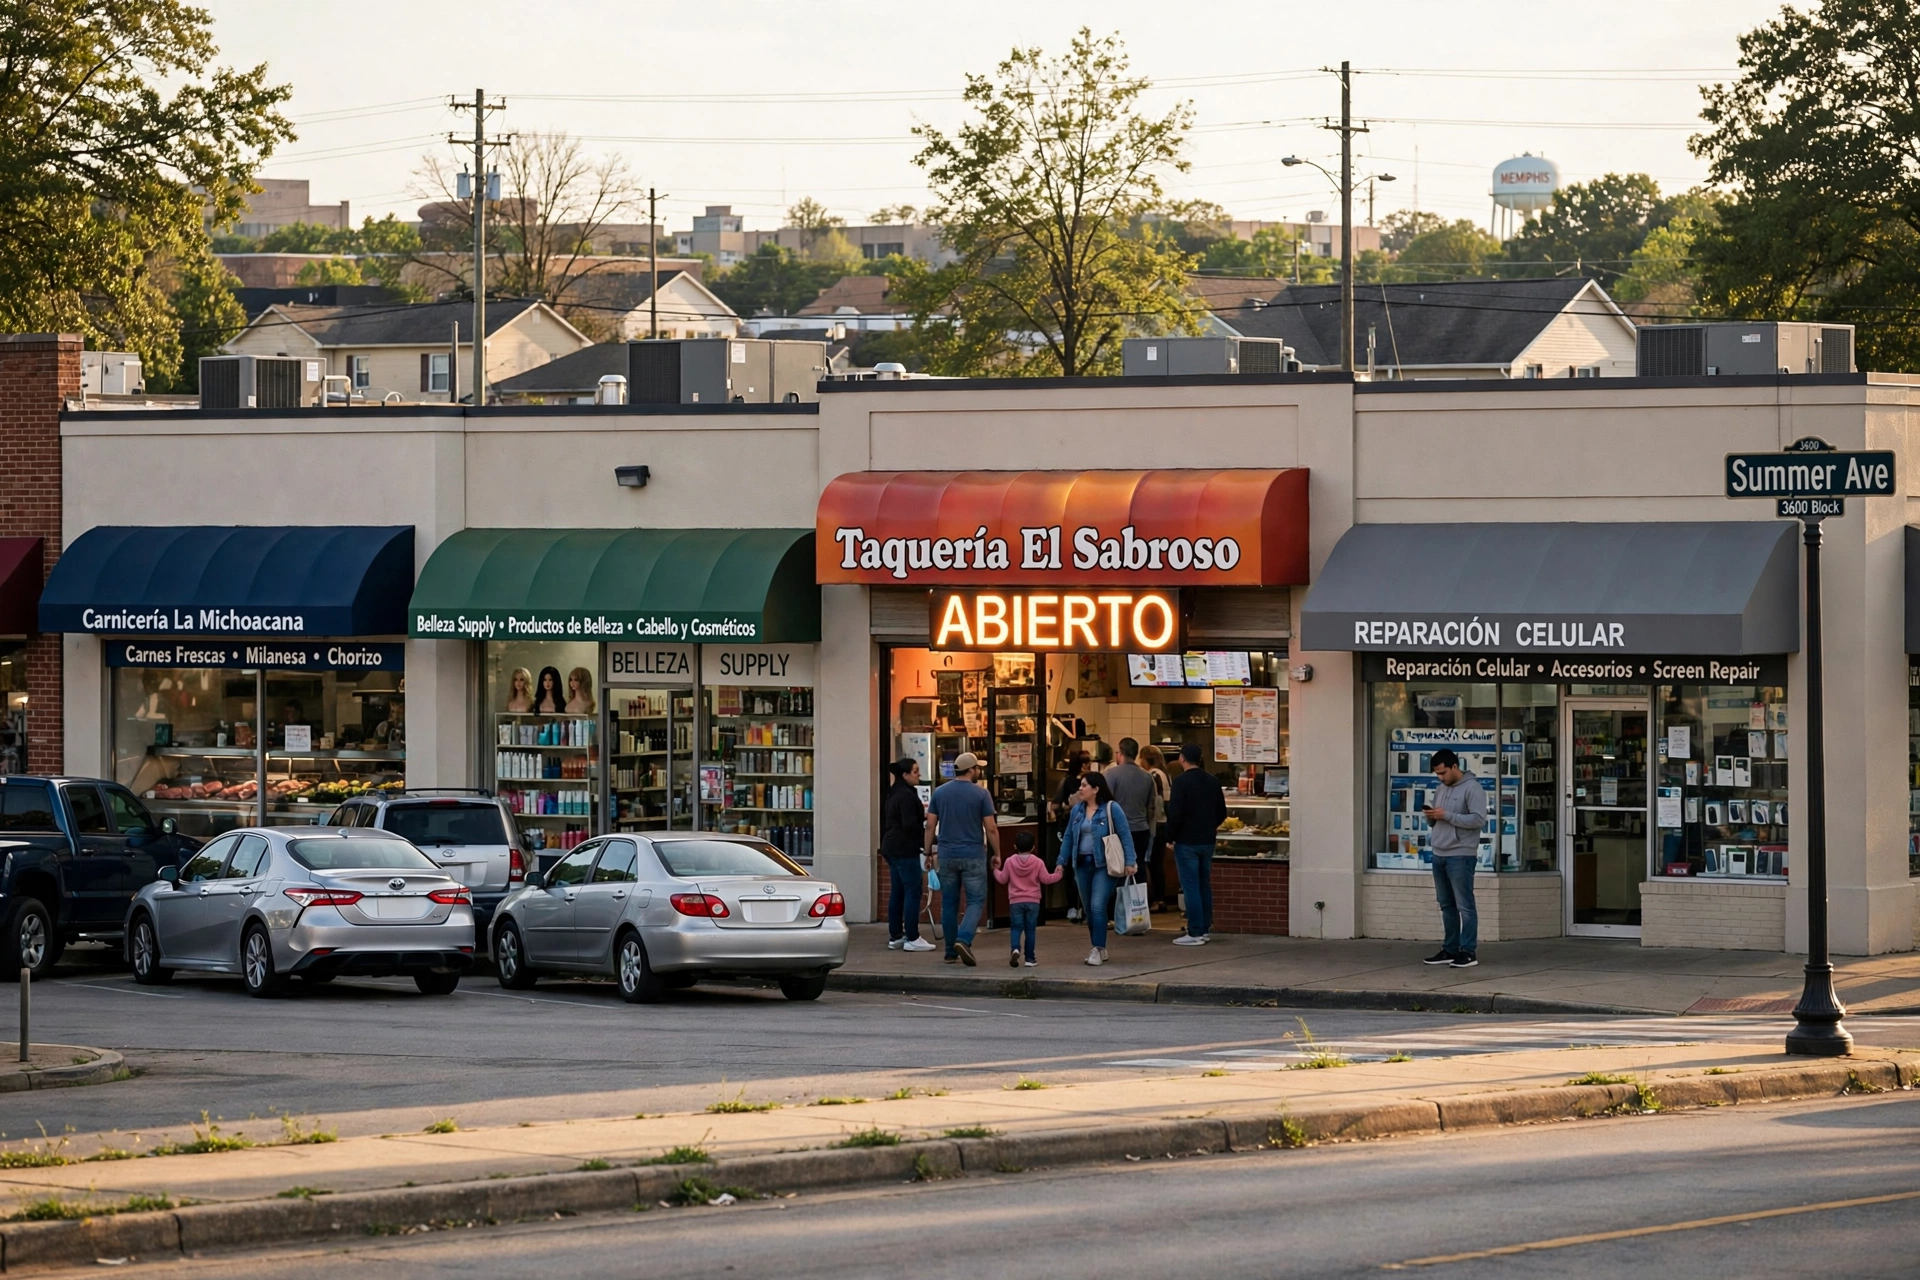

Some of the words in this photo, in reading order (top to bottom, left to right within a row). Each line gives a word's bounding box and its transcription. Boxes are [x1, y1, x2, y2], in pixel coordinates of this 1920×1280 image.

[1500, 172, 1550, 184] MEMPHIS
[1731, 458, 1837, 492] Summer
[1845, 457, 1889, 490] Ave
[1781, 500, 1808, 514] 3600
[1811, 500, 1840, 514] Block
[835, 526, 1010, 579] Taquería
[1020, 526, 1063, 571] El
[1073, 525, 1241, 571] Sabroso
[82, 608, 169, 630] Carnicería
[174, 608, 194, 630] La
[199, 608, 304, 631] Michoacana
[416, 614, 455, 632] Belleza
[457, 614, 496, 638] Supply
[508, 615, 564, 634] Productos
[566, 616, 582, 634] de
[583, 616, 624, 635] Belleza
[636, 617, 678, 636] Cabello
[680, 622, 689, 640] y
[690, 617, 756, 636] Cosméticos
[936, 594, 1175, 648] ABIERTO
[1354, 616, 1500, 646] REPARACIÓN
[1515, 622, 1626, 647] CELULAR
[125, 645, 171, 663] Carnes
[176, 645, 226, 664] Frescas
[246, 645, 307, 665] Milanesa
[327, 647, 382, 665] Chorizo
[612, 651, 690, 674] BELLEZA
[720, 652, 790, 677] SUPPLY
[1386, 657, 1471, 681] Reparación
[1475, 657, 1531, 677] Celular
[1550, 659, 1633, 678] Accesorios
[1653, 660, 1705, 679] Screen
[1709, 661, 1760, 684] Repair
